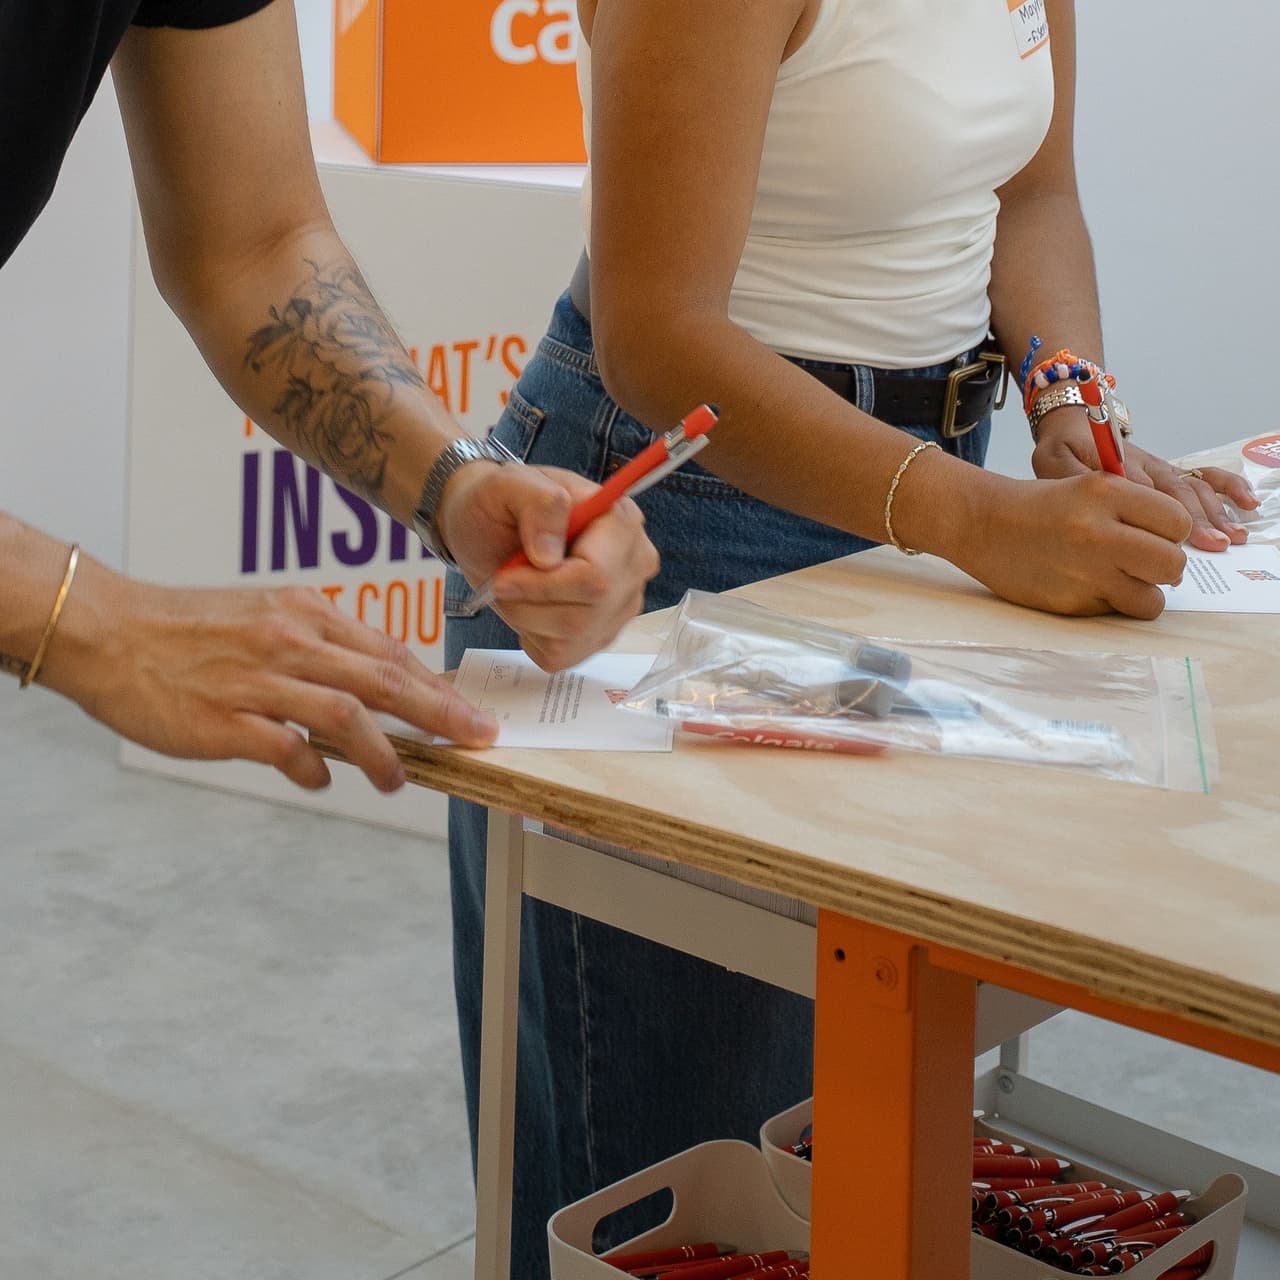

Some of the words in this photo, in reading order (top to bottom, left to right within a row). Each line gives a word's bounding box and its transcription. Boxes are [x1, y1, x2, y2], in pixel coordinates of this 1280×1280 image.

[411, 334, 528, 416] AT'S
[241, 449, 438, 573] INS
[357, 576, 442, 646] COU
